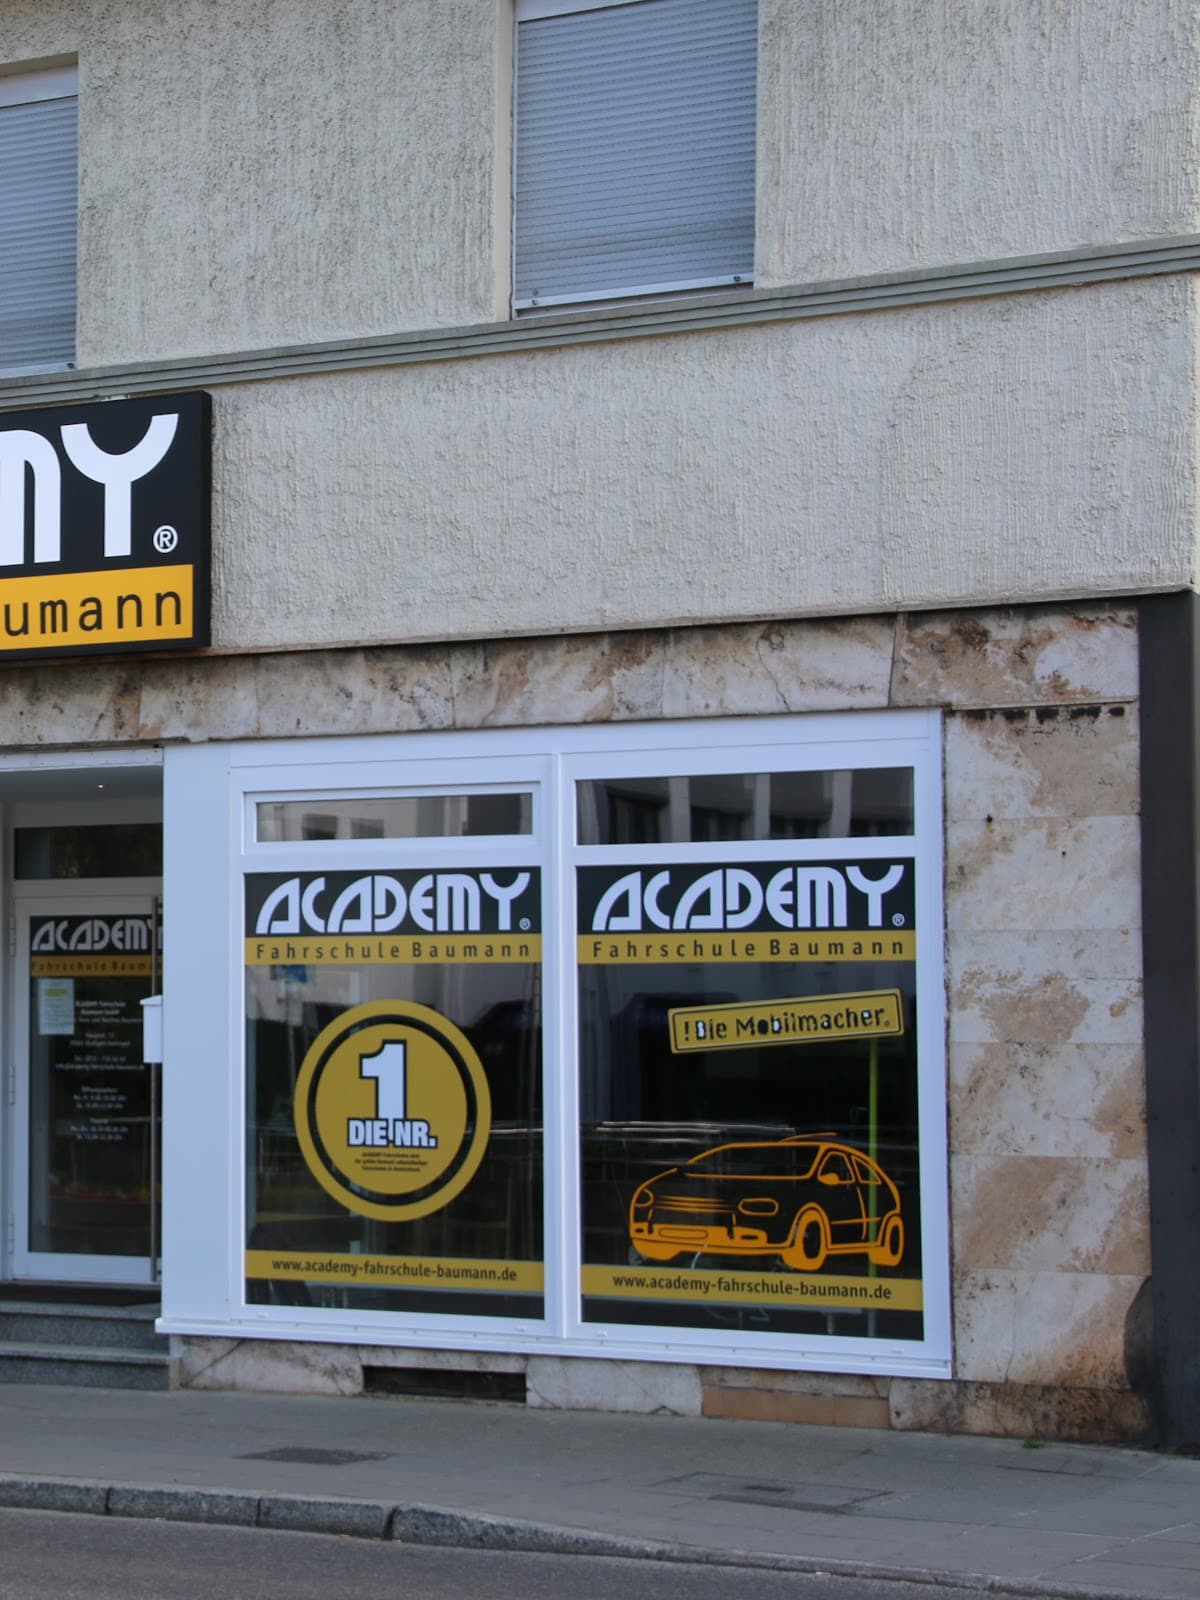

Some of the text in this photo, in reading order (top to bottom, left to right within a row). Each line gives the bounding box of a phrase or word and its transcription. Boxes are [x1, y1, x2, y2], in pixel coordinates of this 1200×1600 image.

[256, 872, 531, 934] ACADEMY
[592, 864, 904, 932] ACADEMY
[256, 941, 530, 960] Fahrschule Baumann
[592, 938, 904, 958] Fahrschule Baumann
[359, 1038, 407, 1120] 1
[347, 1117, 439, 1149] DIE NR.
[271, 1258, 517, 1282] www.academy-fahrschule-baumann.de
[612, 1273, 892, 1300] www.academy-fahrschule-baumann.de
